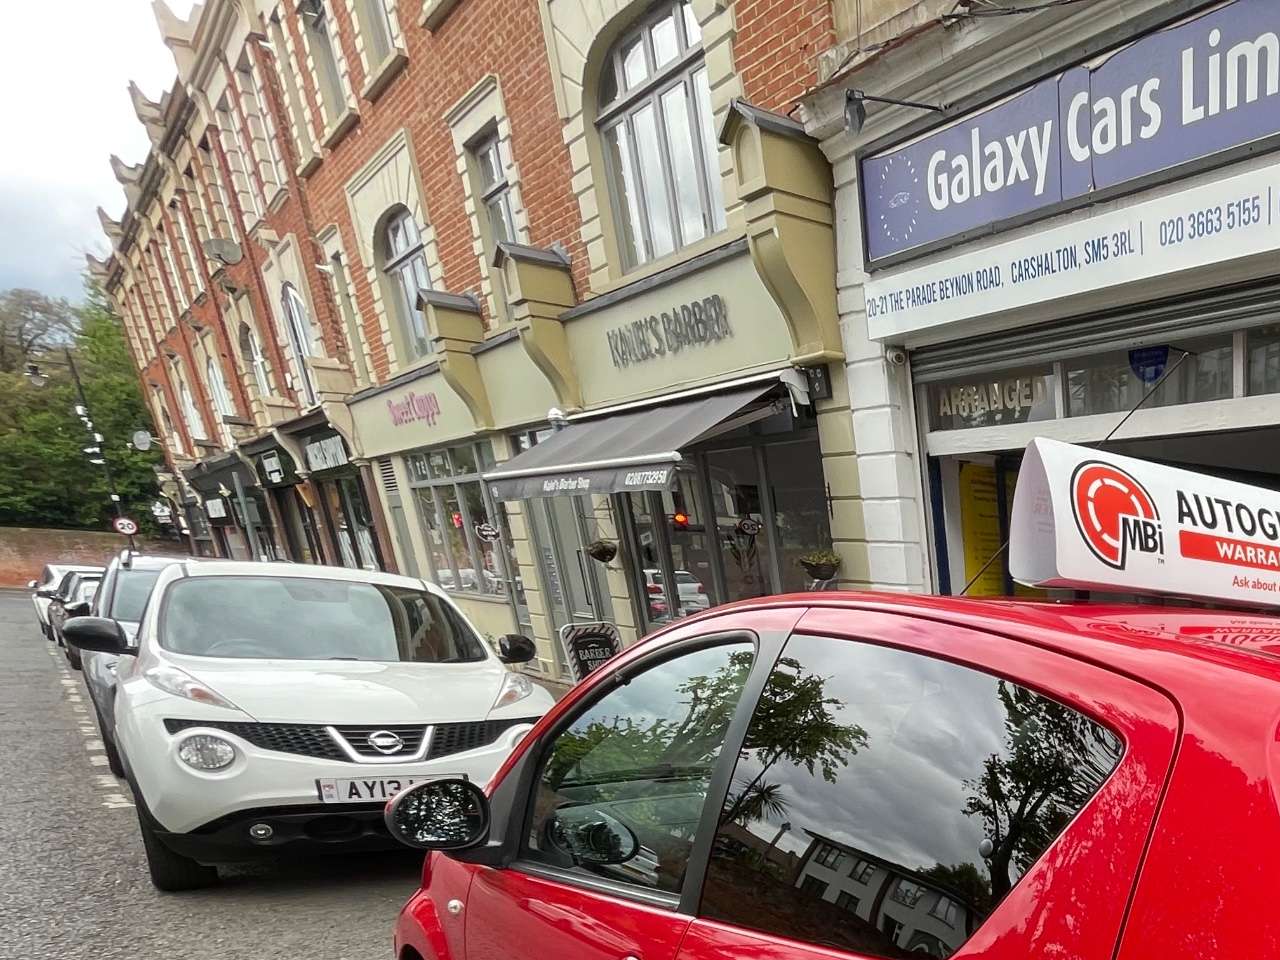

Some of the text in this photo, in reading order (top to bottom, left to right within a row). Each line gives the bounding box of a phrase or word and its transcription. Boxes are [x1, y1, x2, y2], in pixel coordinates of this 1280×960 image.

[928, 118, 1054, 210] Galaxy
[1066, 77, 1162, 162] Cars
[1160, 219, 1184, 246] 020
[1188, 206, 1223, 239] 3663
[1227, 196, 1261, 230] 5155
[867, 229, 1135, 318] 20-21 THE PARADE BEYNON ROAD, CARSHALTON, SM5 3RL
[661, 294, 733, 354] BARBER
[1121, 516, 1164, 556] MBi
[1232, 575, 1250, 588] Ask
[1251, 577, 1276, 592] about
[578, 647, 612, 661] BARBER
[348, 780, 402, 799] AY13
